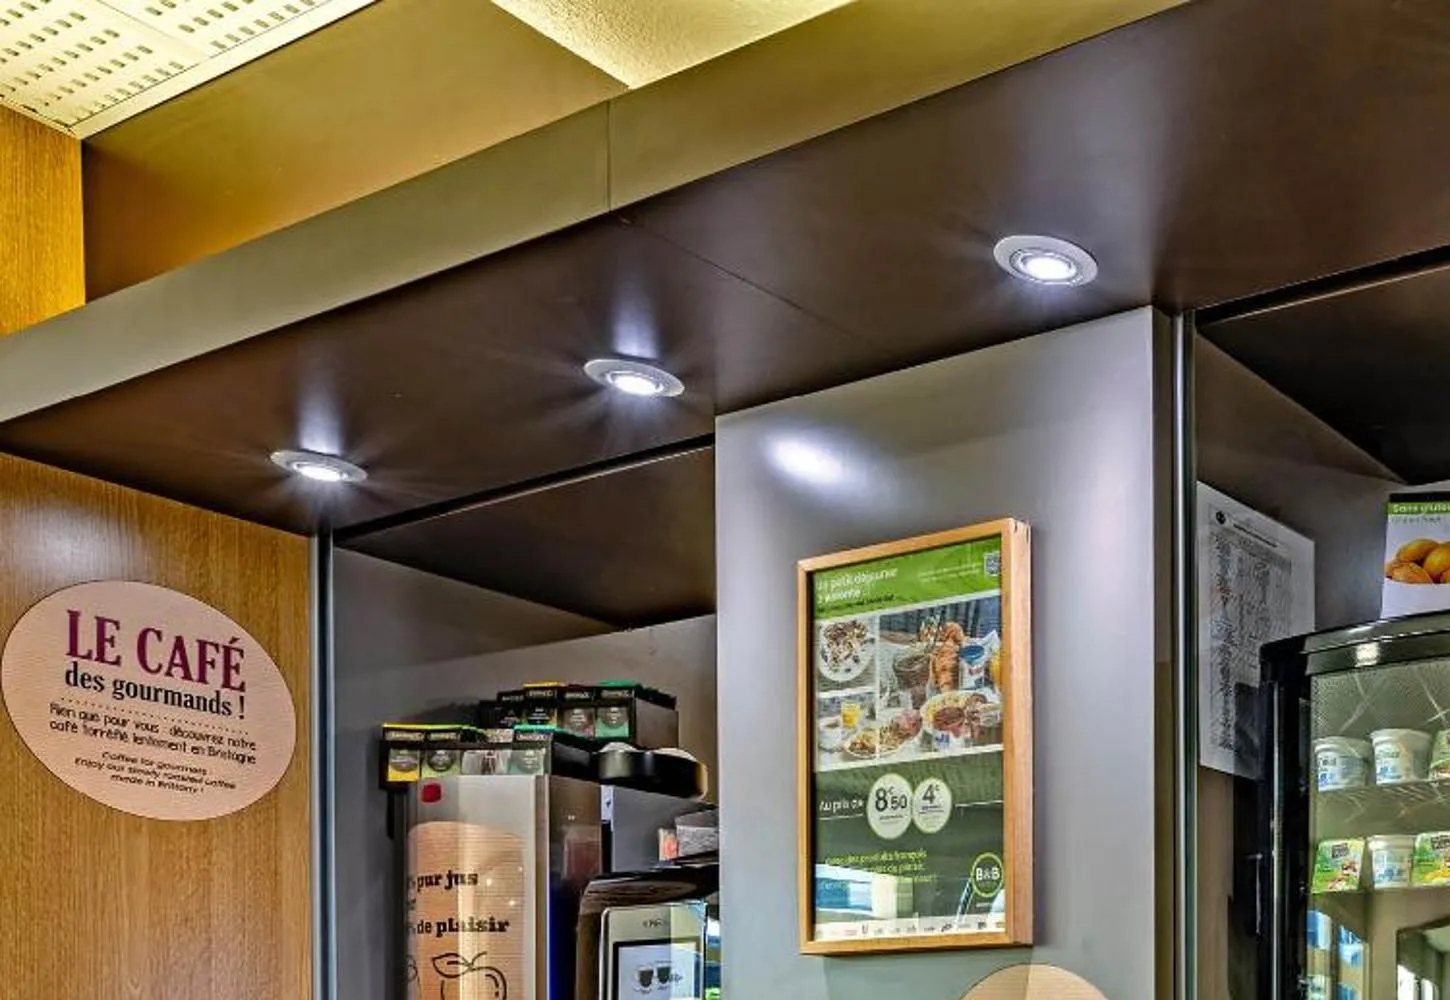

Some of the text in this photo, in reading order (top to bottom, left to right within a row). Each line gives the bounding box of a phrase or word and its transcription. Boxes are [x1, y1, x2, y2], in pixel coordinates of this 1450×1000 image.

[66, 609, 247, 693] LE CAFÉ
[65, 661, 245, 720] des gourmands !
[78, 709, 100, 723] que
[104, 714, 130, 729] pour
[134, 721, 160, 733] vous
[50, 719, 78, 734] café
[191, 744, 205, 755] en
[417, 869, 479, 892] pur jus
[417, 915, 510, 938] de plaisir
